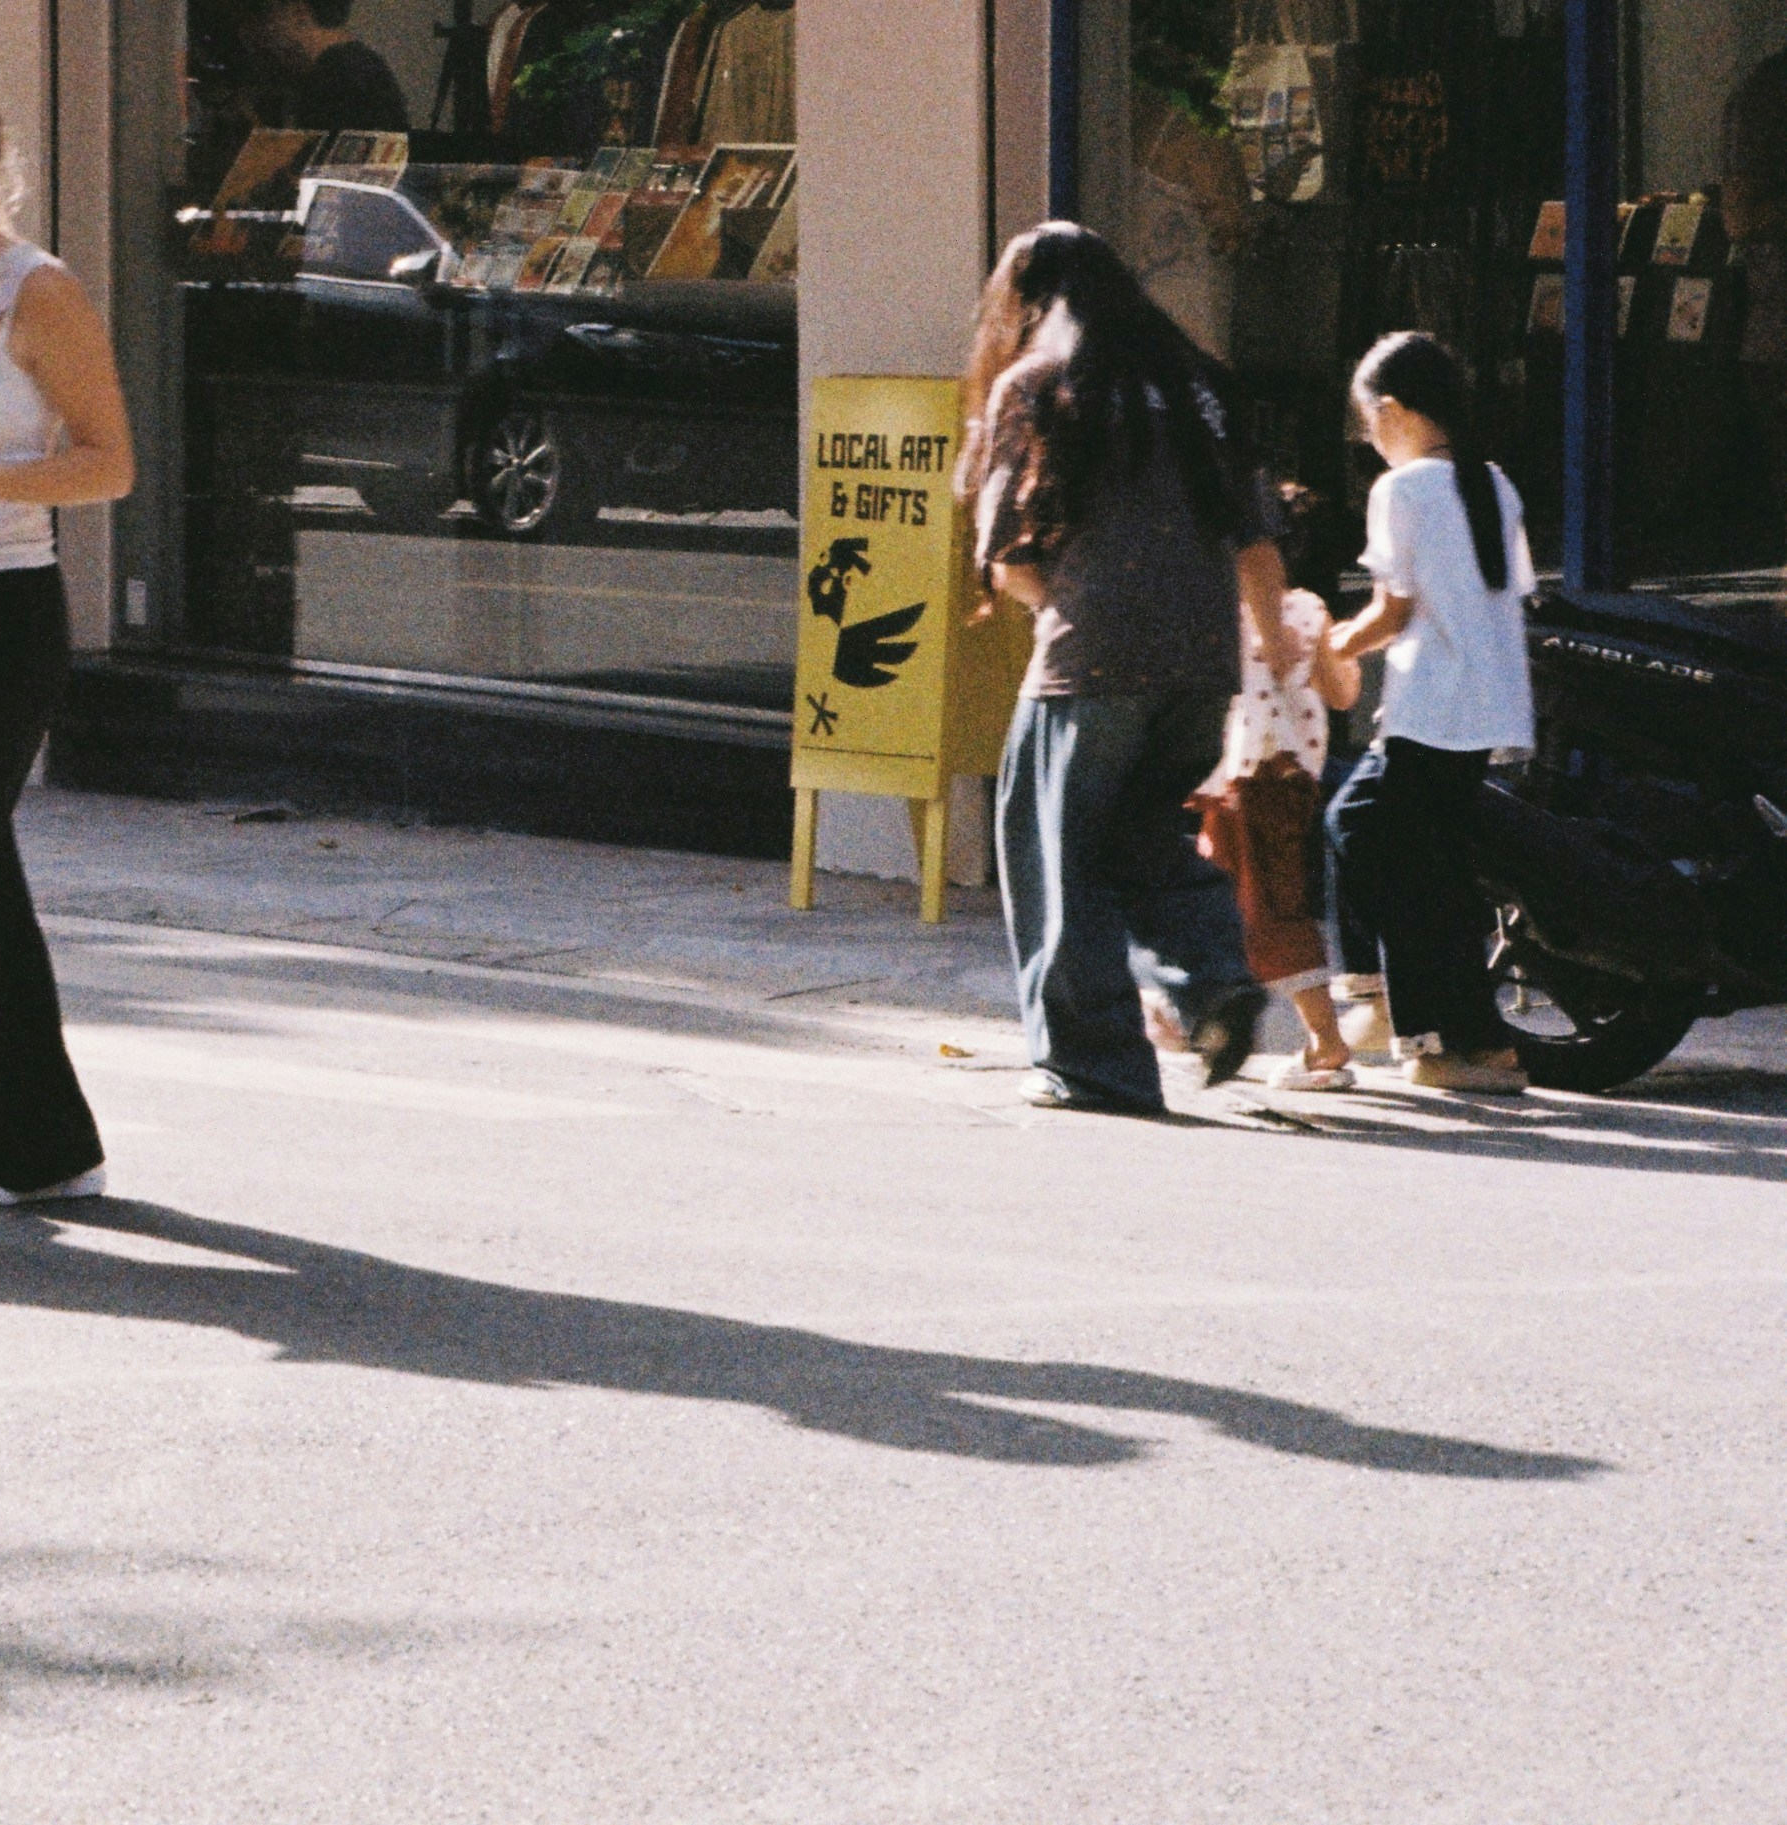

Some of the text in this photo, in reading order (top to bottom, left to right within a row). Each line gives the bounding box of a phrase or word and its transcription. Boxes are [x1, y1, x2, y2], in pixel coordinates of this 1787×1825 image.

[818, 432, 949, 472] LOCAL ART
[831, 481, 929, 526] & GIFTS
